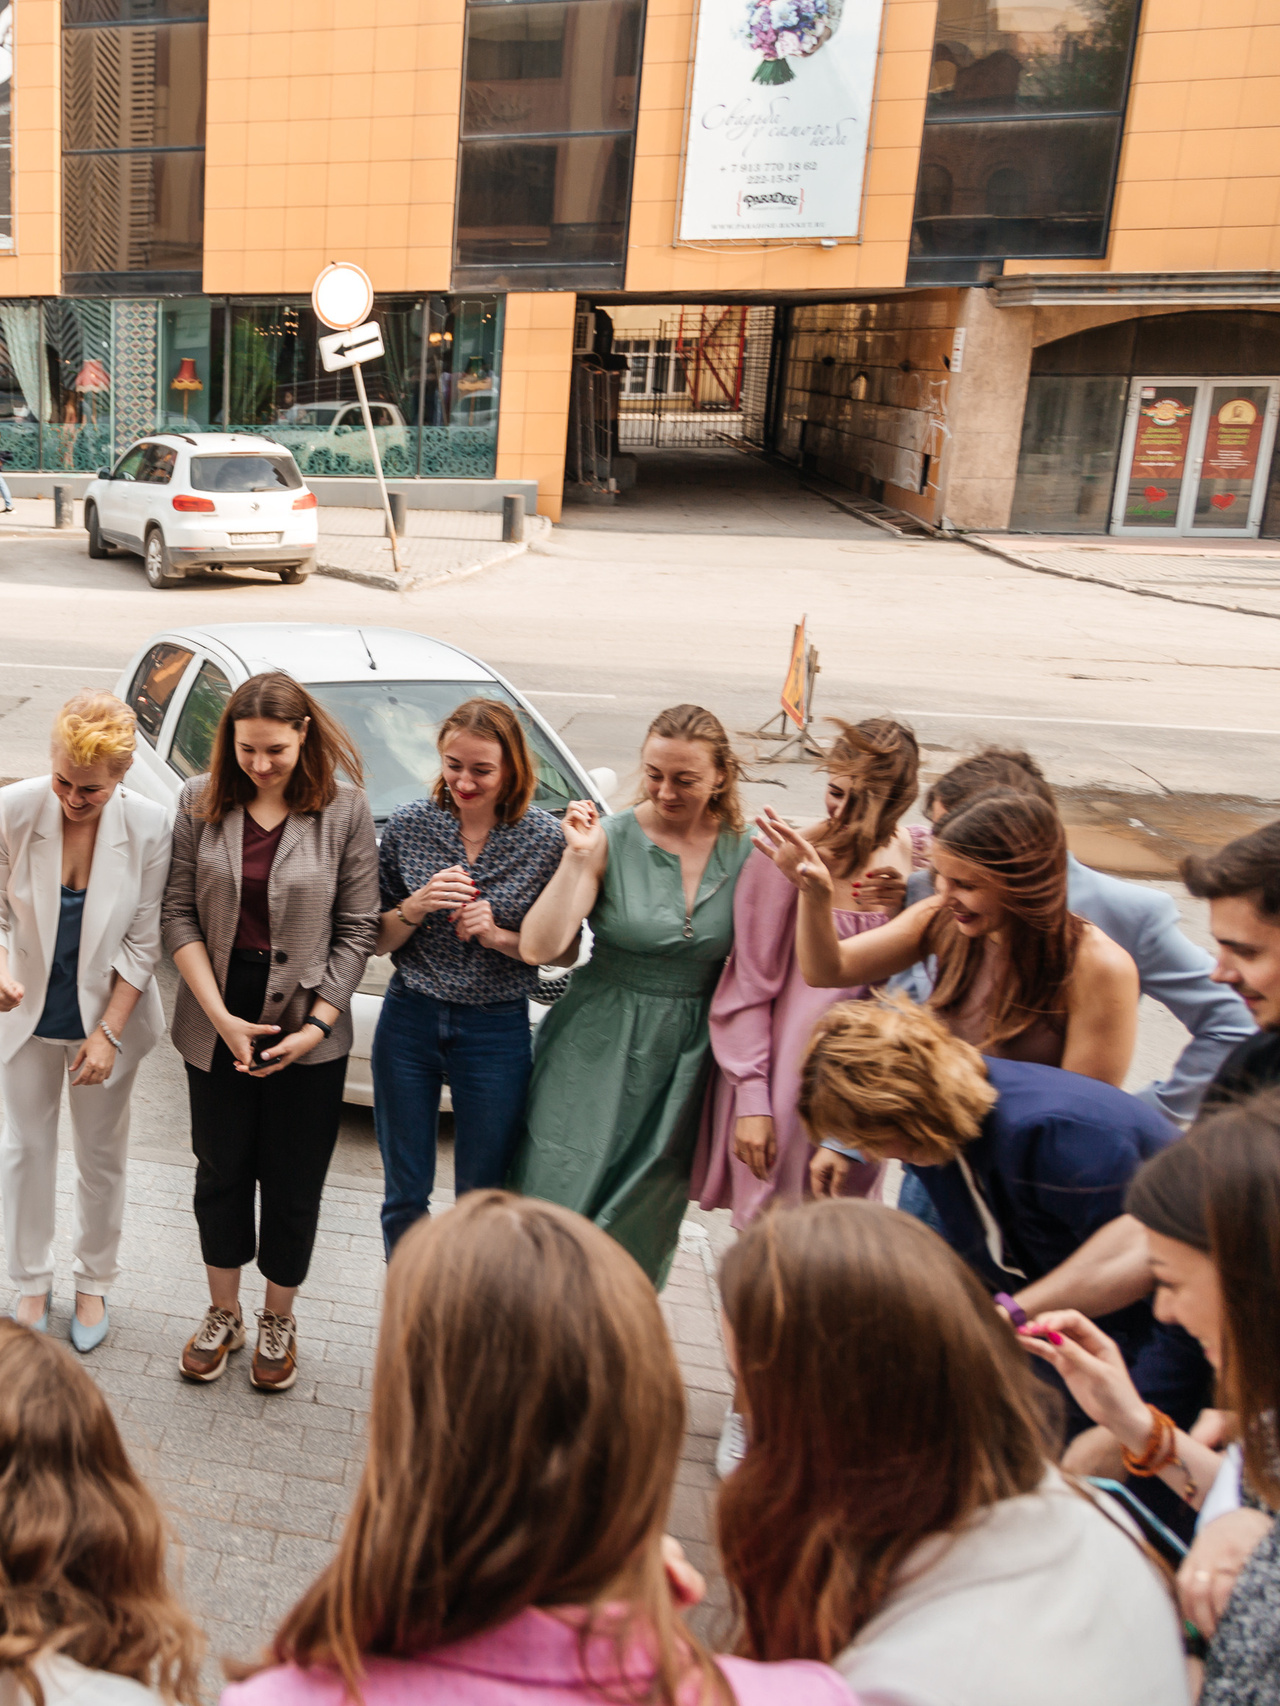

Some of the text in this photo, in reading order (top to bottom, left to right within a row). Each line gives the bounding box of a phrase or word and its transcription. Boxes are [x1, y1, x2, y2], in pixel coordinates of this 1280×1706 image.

[740, 162, 760, 172] 913
[765, 162, 784, 171] 770
[788, 161, 801, 171] 18
[803, 161, 818, 170] 62
[746, 174, 801, 184] 222-15-87
[743, 191, 799, 209] PARADISE
